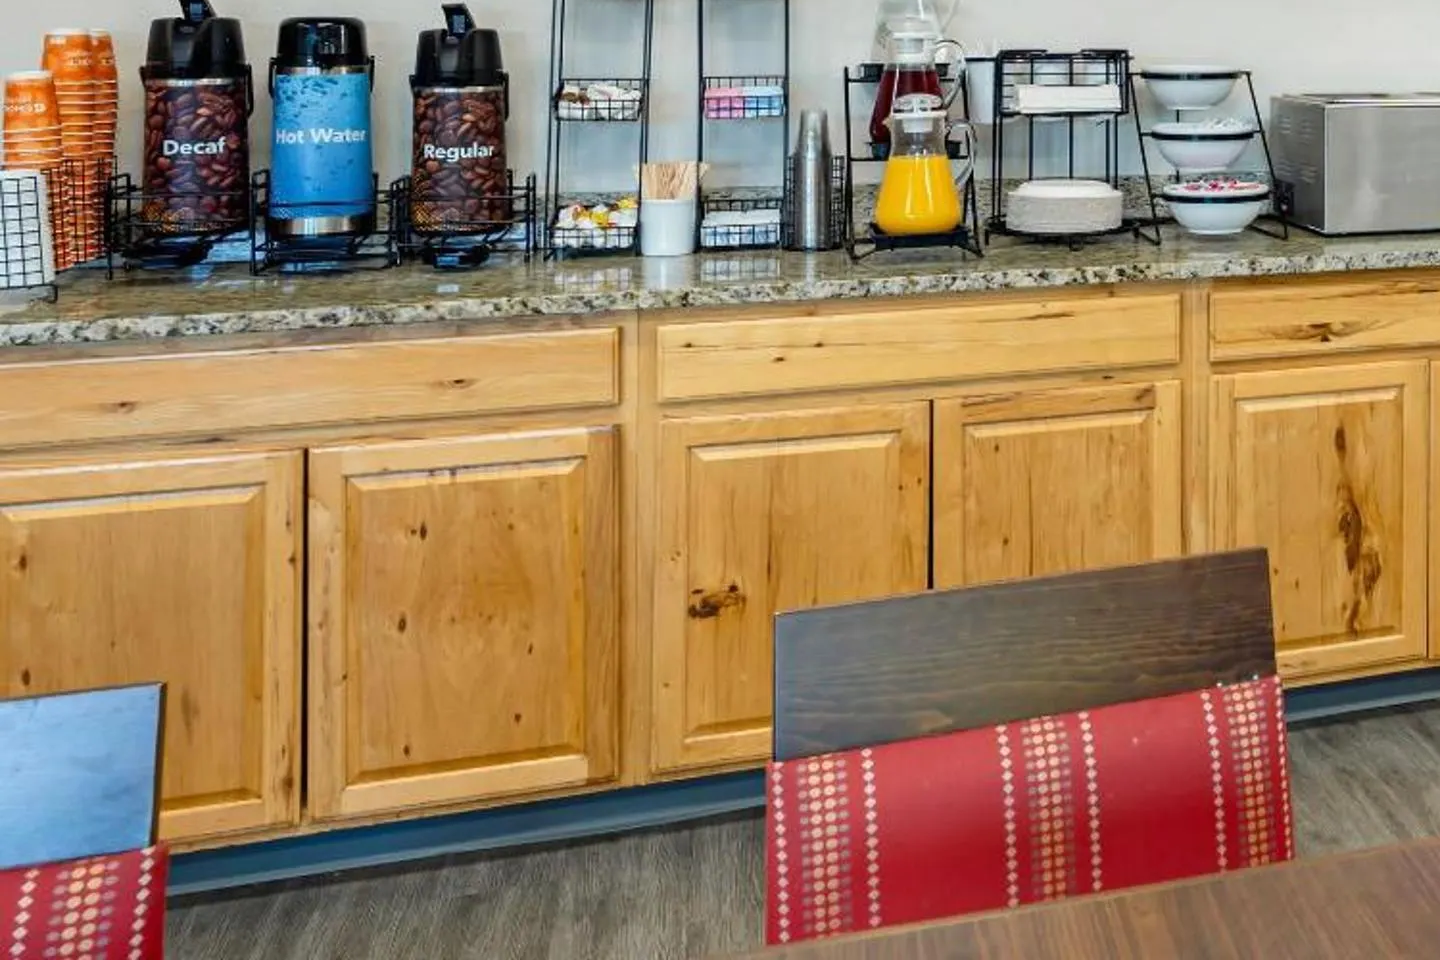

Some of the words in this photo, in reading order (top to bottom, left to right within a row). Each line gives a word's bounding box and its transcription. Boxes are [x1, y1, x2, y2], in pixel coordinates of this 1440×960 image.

[276, 128, 304, 144] Hot
[310, 127, 366, 143] Water
[163, 136, 226, 155] Decaf
[423, 142, 494, 162] Regular
